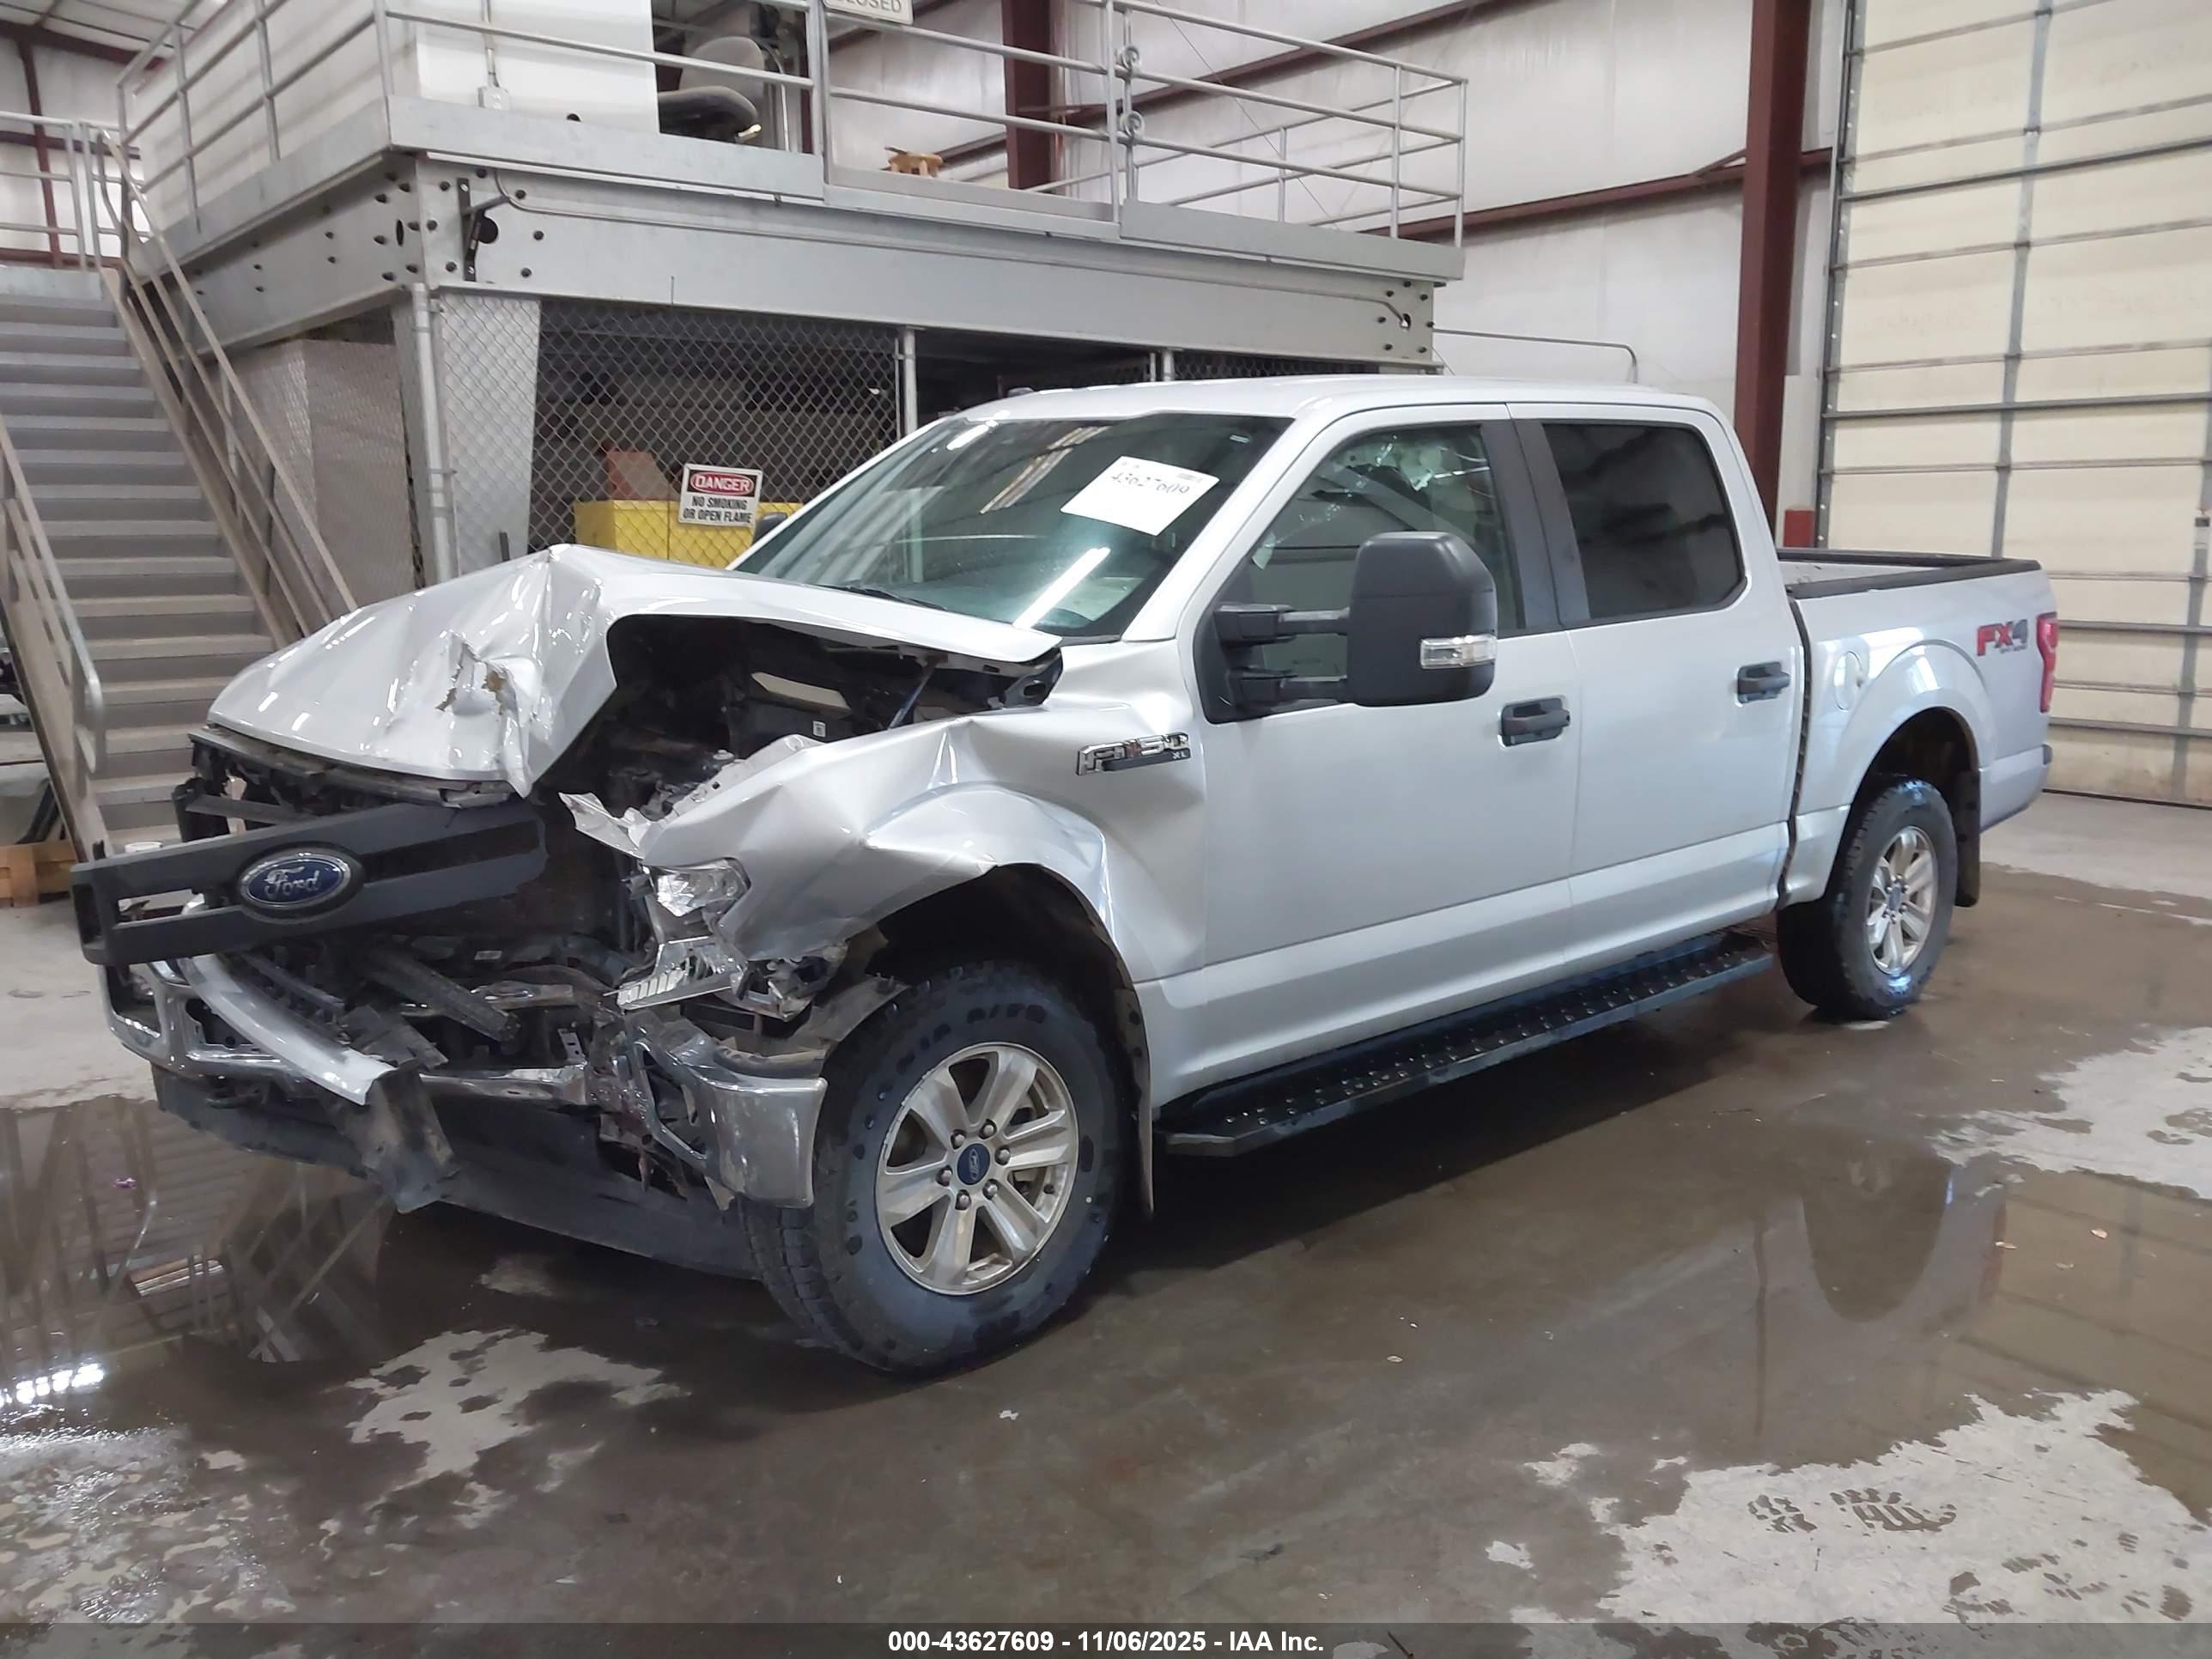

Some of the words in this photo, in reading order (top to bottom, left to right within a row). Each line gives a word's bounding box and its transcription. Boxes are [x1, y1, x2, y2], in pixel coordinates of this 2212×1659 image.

[695, 474, 750, 492] DANGER
[692, 495, 705, 507] NO
[707, 496, 748, 510] SMOKING
[683, 507, 696, 519] OR
[698, 508, 722, 521] OPEN
[724, 510, 752, 523] FLAME
[1977, 618, 2028, 657] FX4
[1172, 751, 1188, 760] XL
[264, 866, 320, 897] Ford
